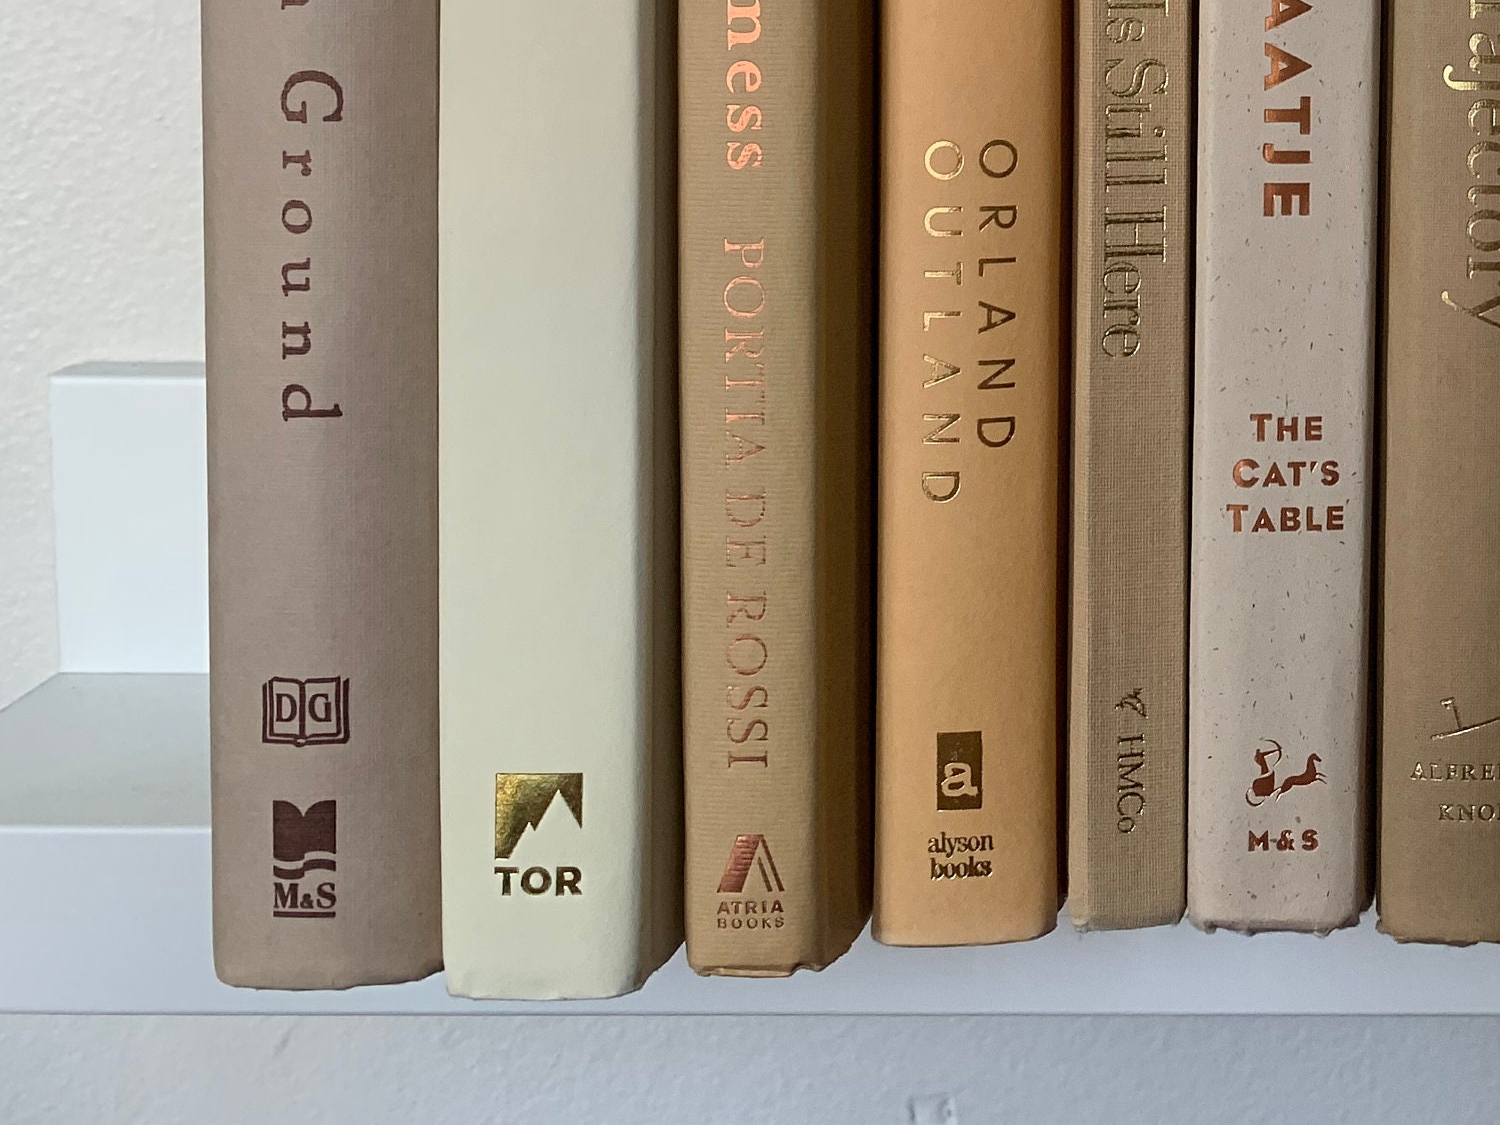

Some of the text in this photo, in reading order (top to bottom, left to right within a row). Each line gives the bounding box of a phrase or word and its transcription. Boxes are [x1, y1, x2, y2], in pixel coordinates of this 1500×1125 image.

[1104, 60, 1169, 190] Still
[279, 68, 344, 423] Ground
[977, 138, 1019, 449] ORLAND
[1101, 206, 1167, 359] Here
[922, 139, 965, 503] OUTLAND
[1250, 414, 1323, 442] THE
[1232, 459, 1340, 488] CAT'S
[721, 236, 769, 769] PORTIA DE ROSSI
[1226, 504, 1345, 532] TABLE
[1116, 735, 1147, 834] HMCo
[927, 830, 994, 856] alyson
[493, 865, 583, 896] TOR
[929, 856, 992, 879] books
[716, 900, 784, 916] ATRIA
[716, 916, 784, 930] BOOKS
